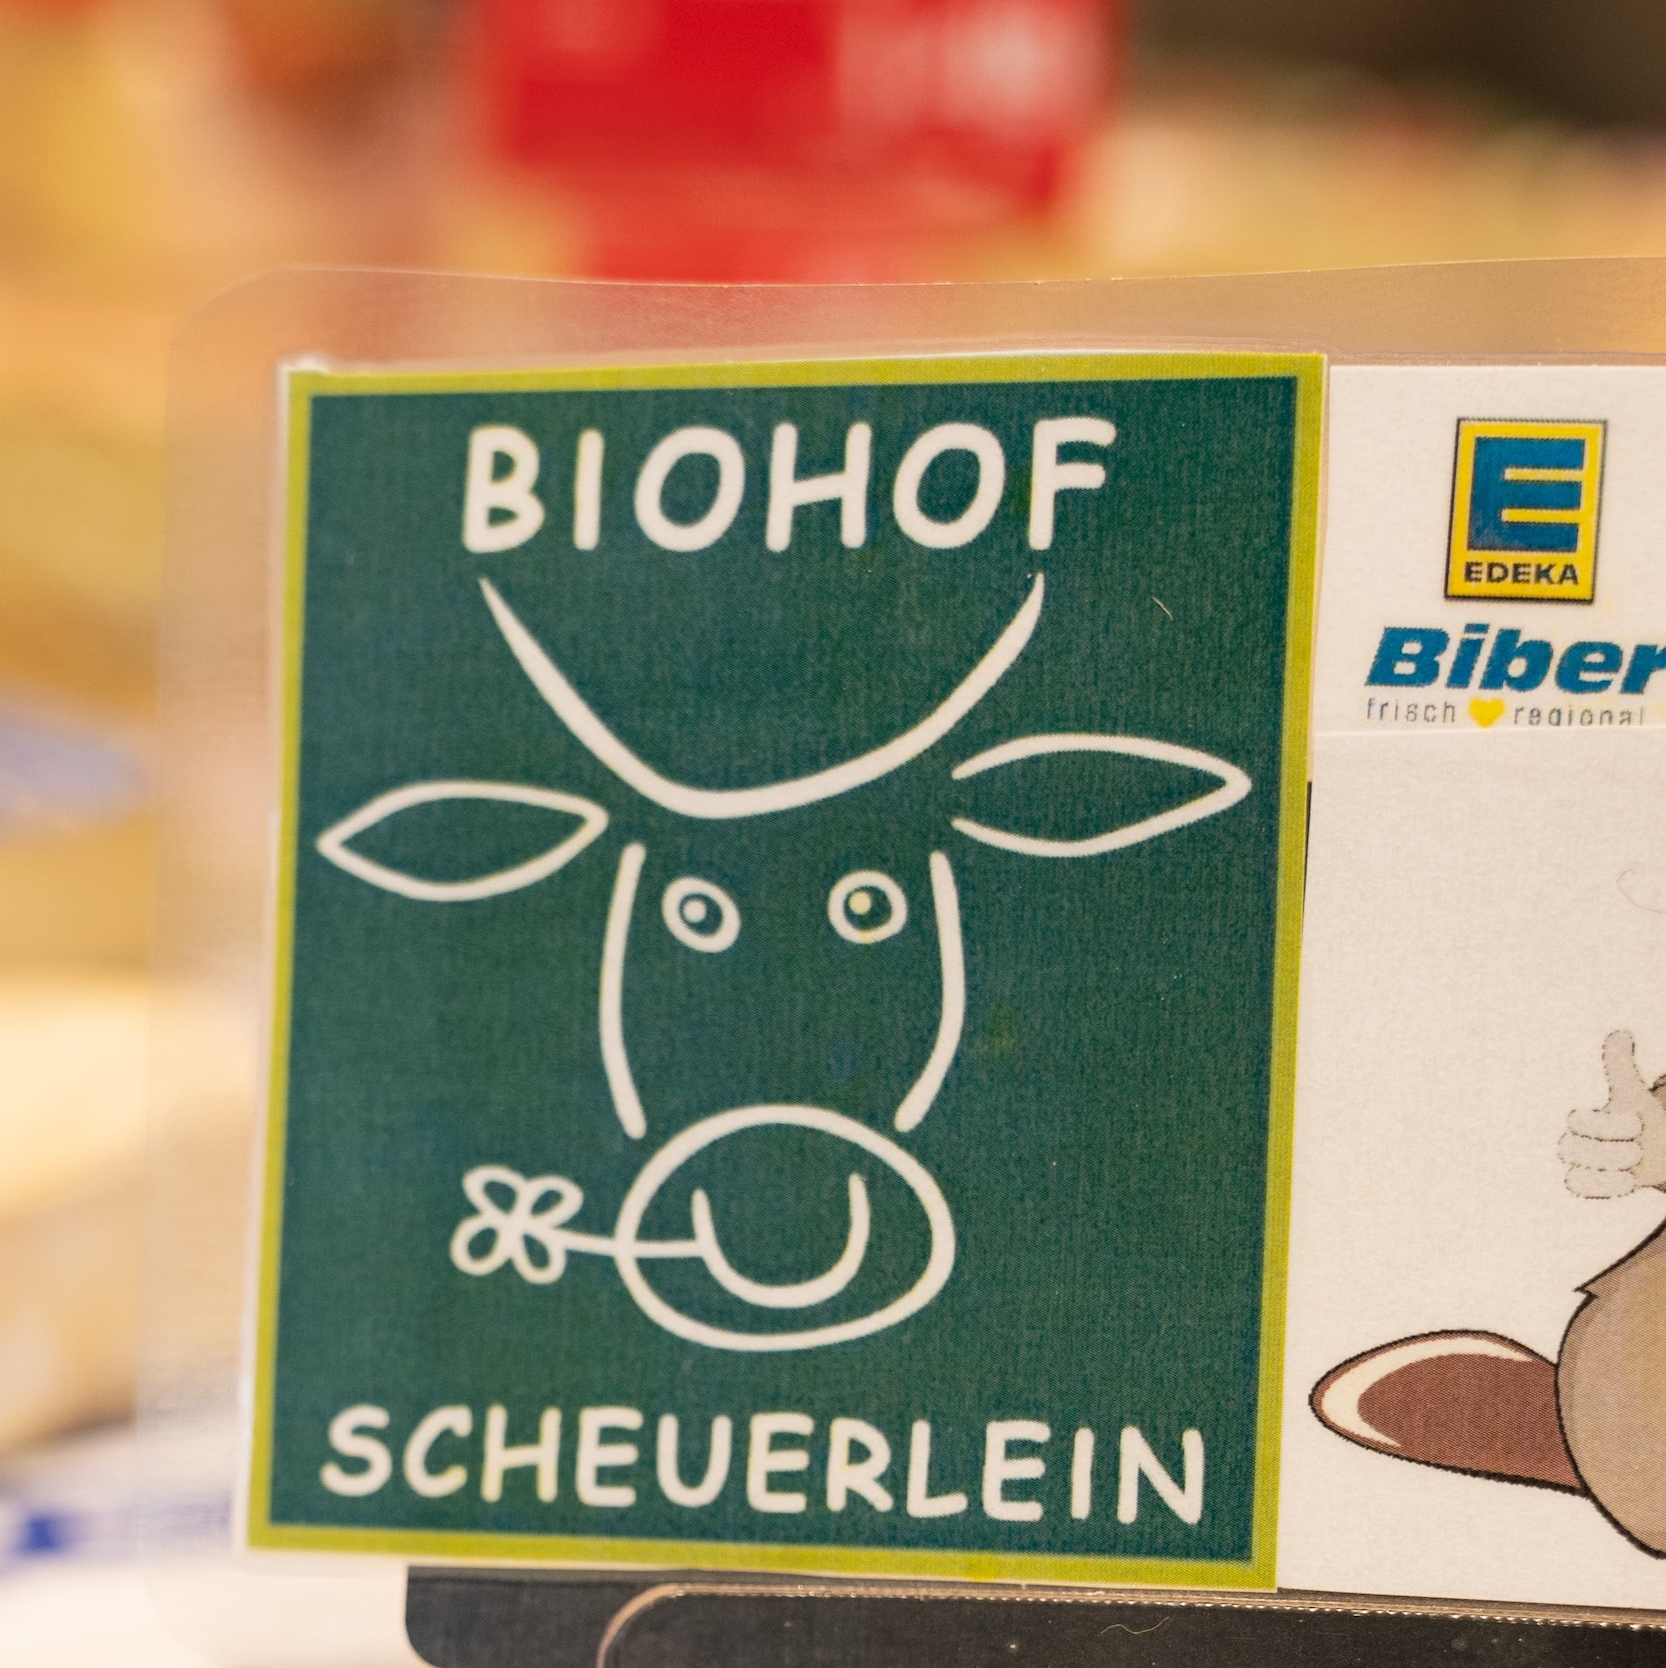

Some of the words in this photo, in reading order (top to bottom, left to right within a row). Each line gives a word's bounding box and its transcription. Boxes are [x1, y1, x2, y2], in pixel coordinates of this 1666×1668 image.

[463, 417, 1117, 554] BIOHOF
[1463, 561, 1580, 586] EDEKA
[1365, 697, 1456, 724] frisch
[1513, 703, 1645, 727] regional
[320, 1402, 1207, 1526] SCHEUERLEIN
